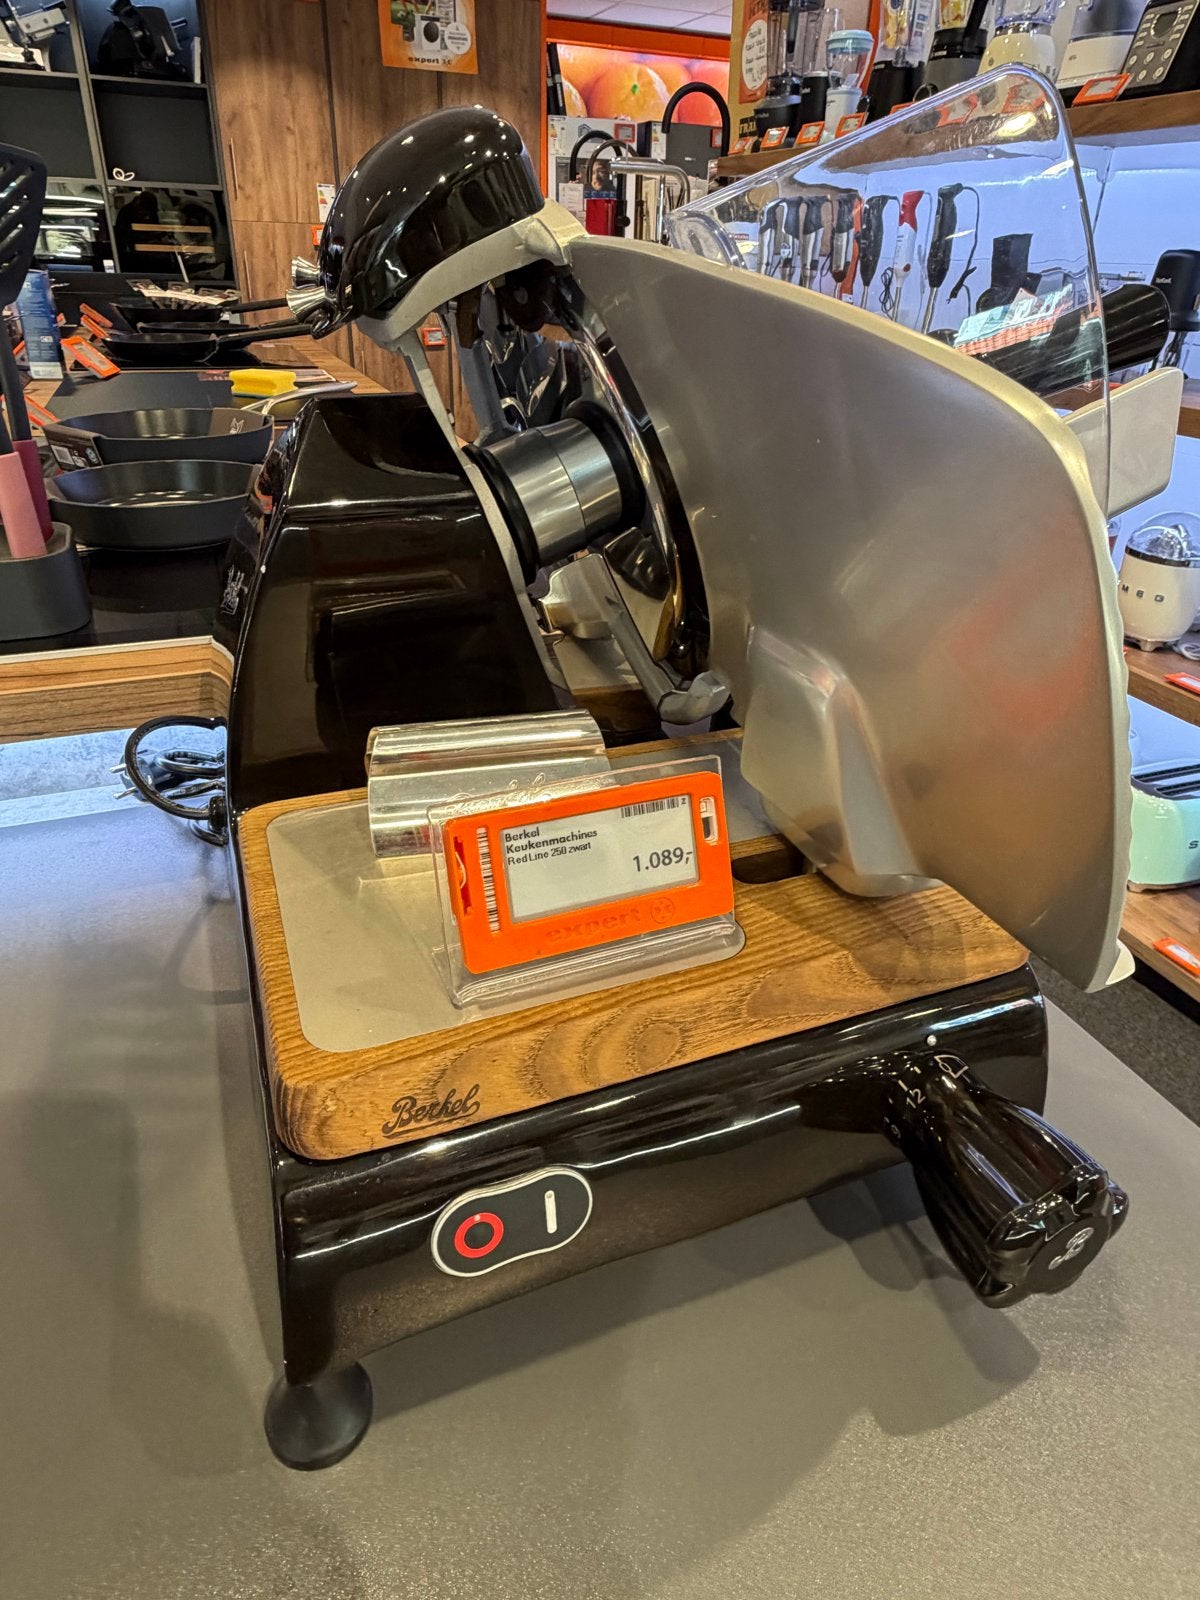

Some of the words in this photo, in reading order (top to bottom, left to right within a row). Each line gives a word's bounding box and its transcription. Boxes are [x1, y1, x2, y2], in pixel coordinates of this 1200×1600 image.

[408, 56, 440, 65] expert
[1121, 584, 1165, 603] MEG
[505, 826, 540, 843] Berkel
[506, 830, 598, 854] Keukenmachines
[1188, 840, 1199, 849] S
[550, 845, 567, 857] 250
[568, 842, 591, 853] zwart
[632, 846, 693, 872] 1.089,-
[546, 908, 641, 941] expert
[906, 1088, 926, 1109] 12
[381, 1083, 481, 1139] Berkel
